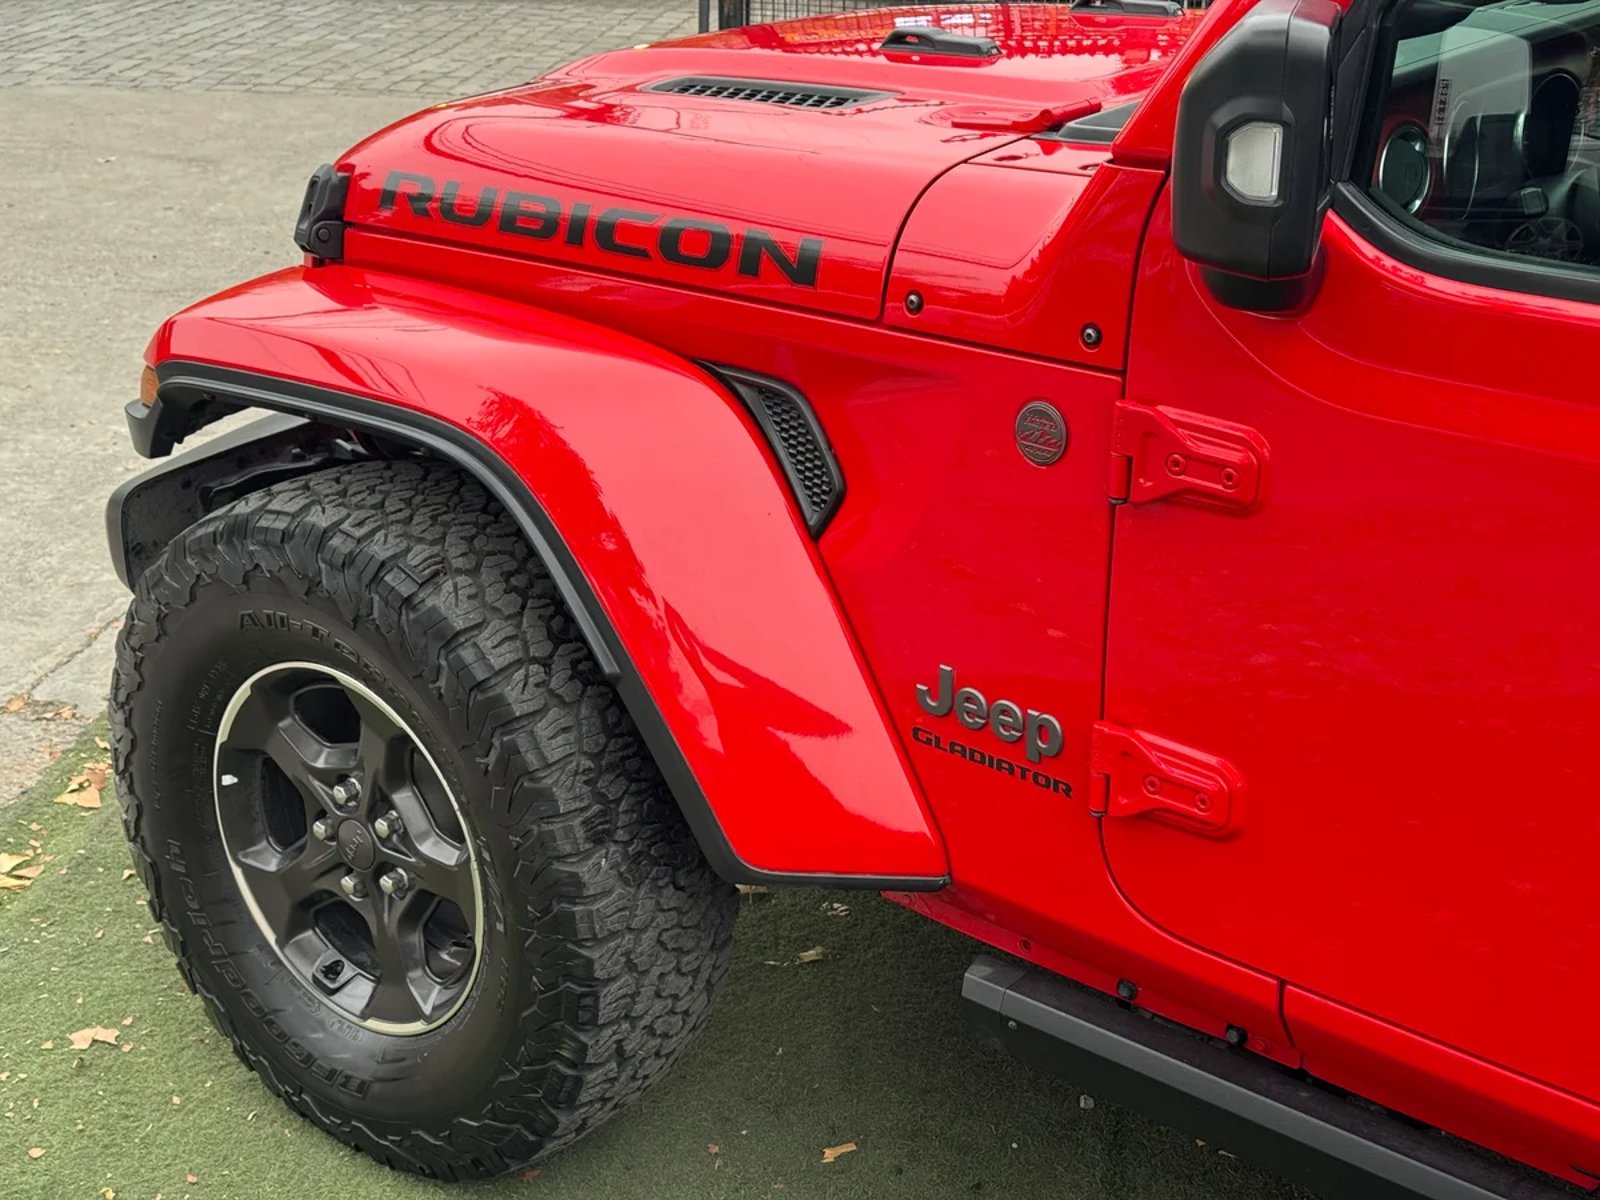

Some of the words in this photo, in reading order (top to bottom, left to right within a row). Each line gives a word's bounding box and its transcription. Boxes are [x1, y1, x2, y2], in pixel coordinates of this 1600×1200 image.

[377, 170, 825, 289] RUBICON
[911, 726, 1073, 799] GLADIATOR
[915, 663, 1064, 764] Jeep
